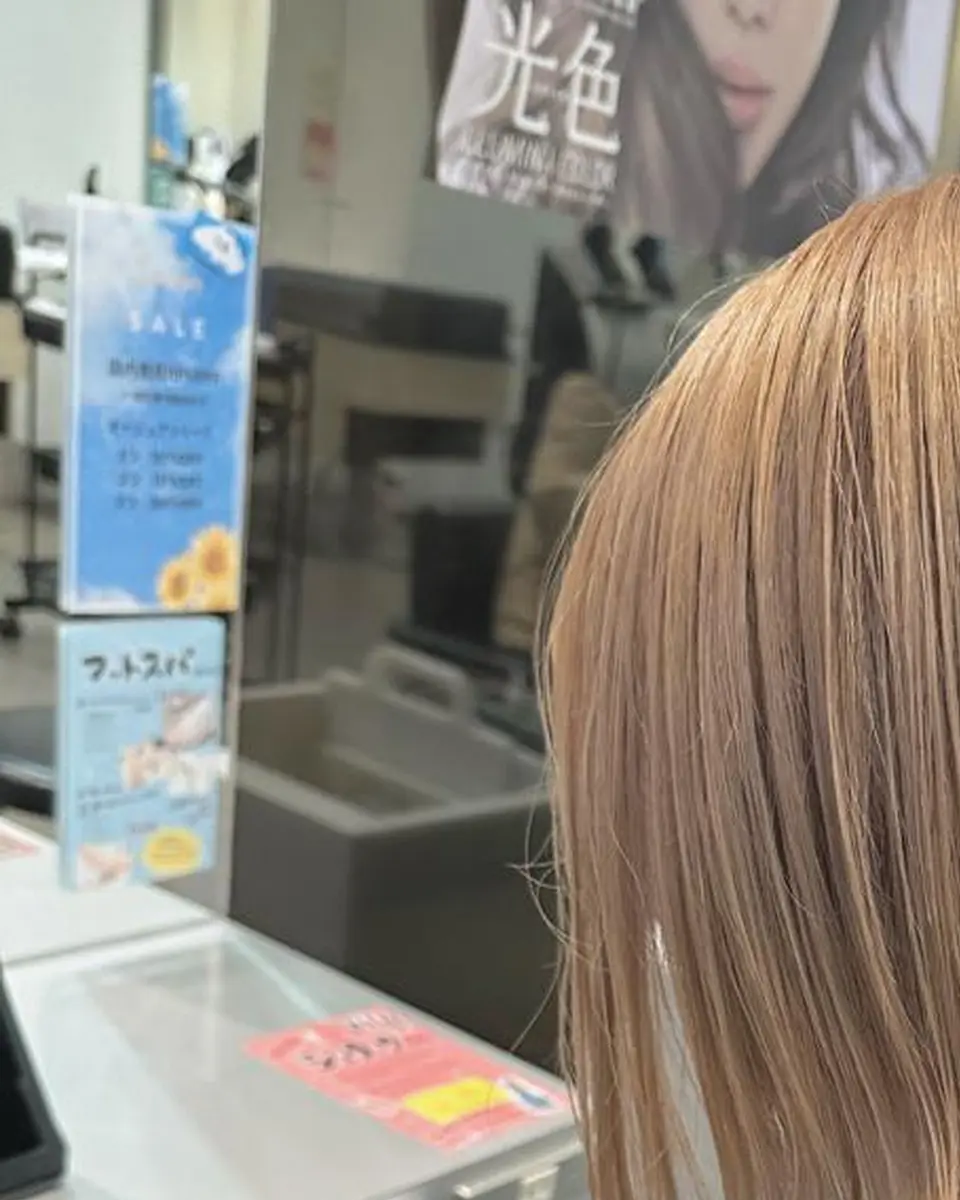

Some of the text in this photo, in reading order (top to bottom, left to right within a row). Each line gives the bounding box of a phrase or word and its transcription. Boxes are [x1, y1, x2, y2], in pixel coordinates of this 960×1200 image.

[465, 0, 621, 154] 光色
[129, 310, 207, 340] SALE
[82, 646, 197, 682] フットスパ
